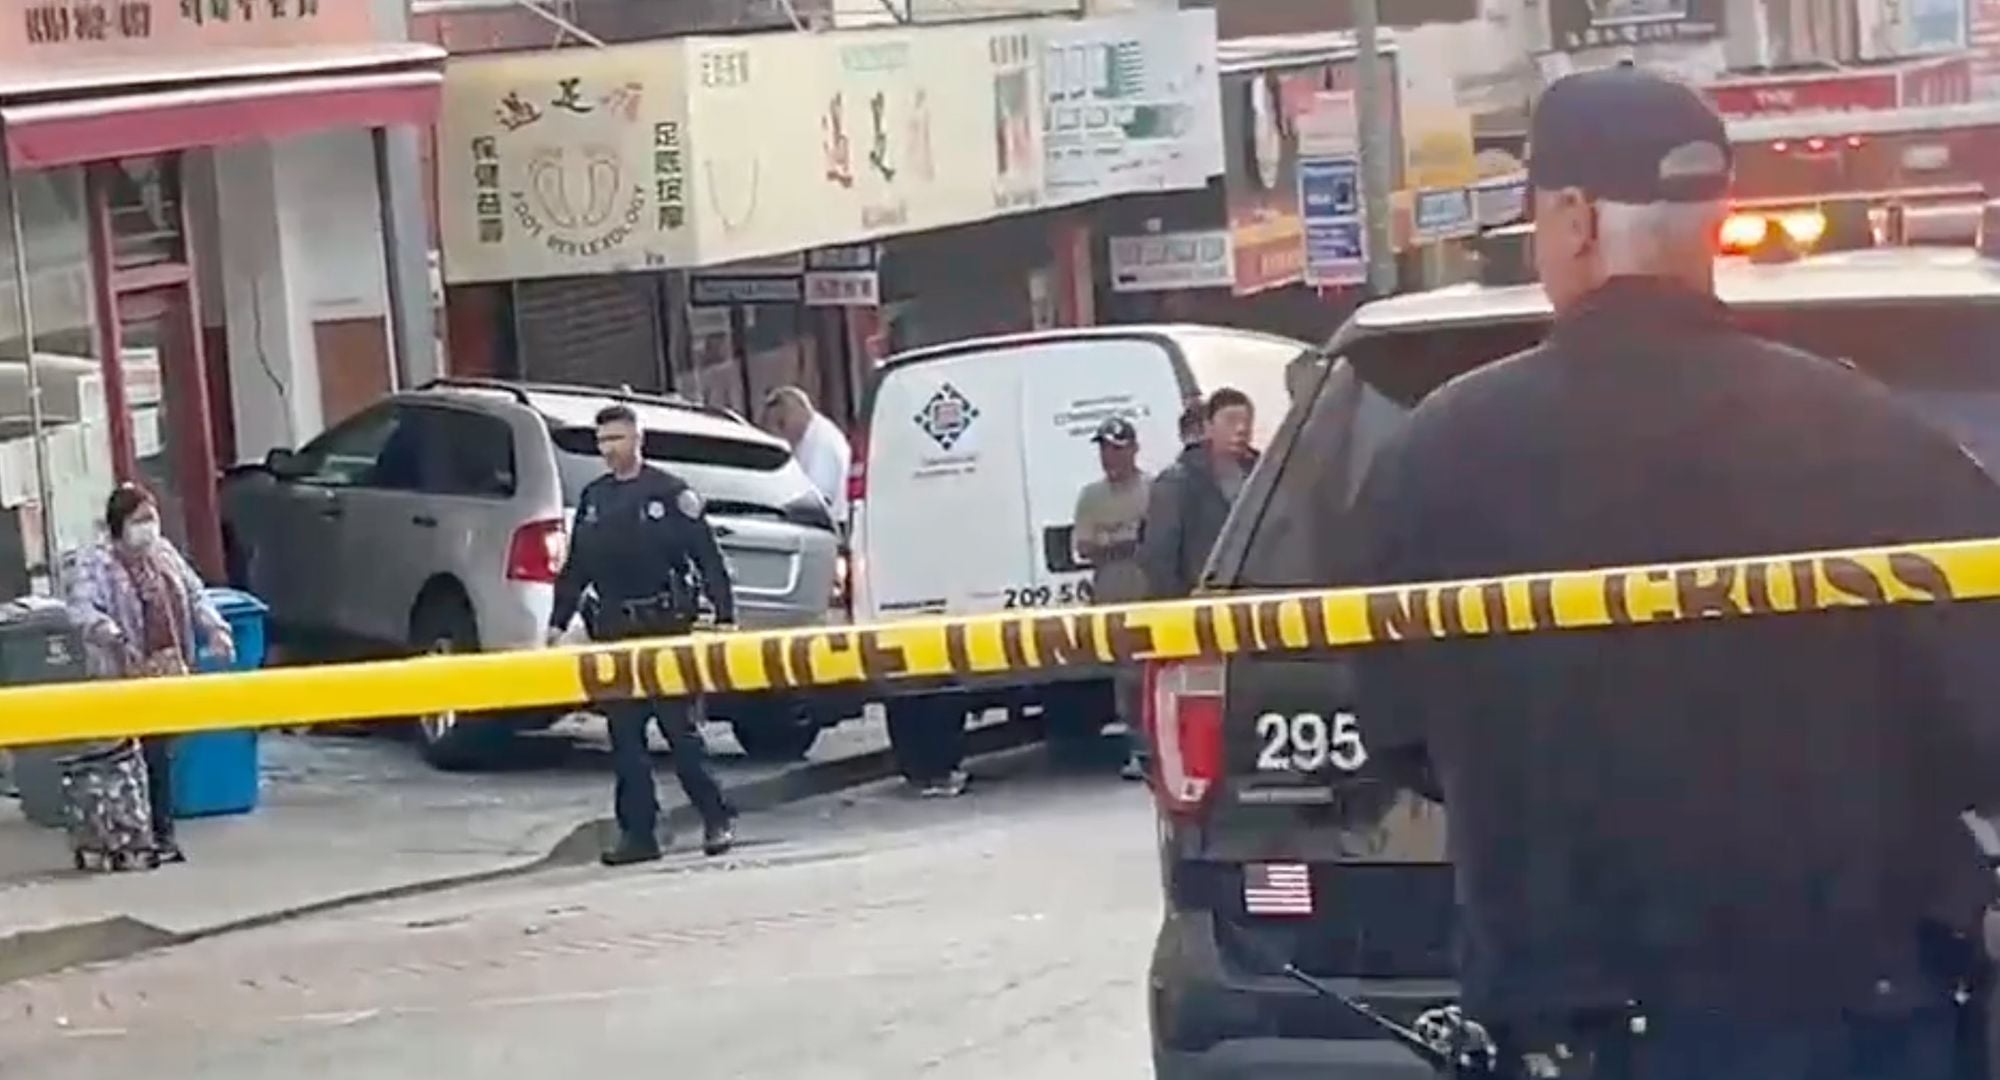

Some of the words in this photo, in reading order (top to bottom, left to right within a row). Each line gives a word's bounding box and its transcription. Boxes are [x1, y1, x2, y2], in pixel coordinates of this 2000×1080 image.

[579, 630, 907, 697] POLICE
[945, 610, 1157, 675] LINE
[1197, 595, 1330, 652] DO
[1366, 577, 1556, 639] NOT
[1606, 551, 1954, 622] CROSS
[1004, 588, 1051, 610] 209
[1256, 712, 1368, 770] 295
